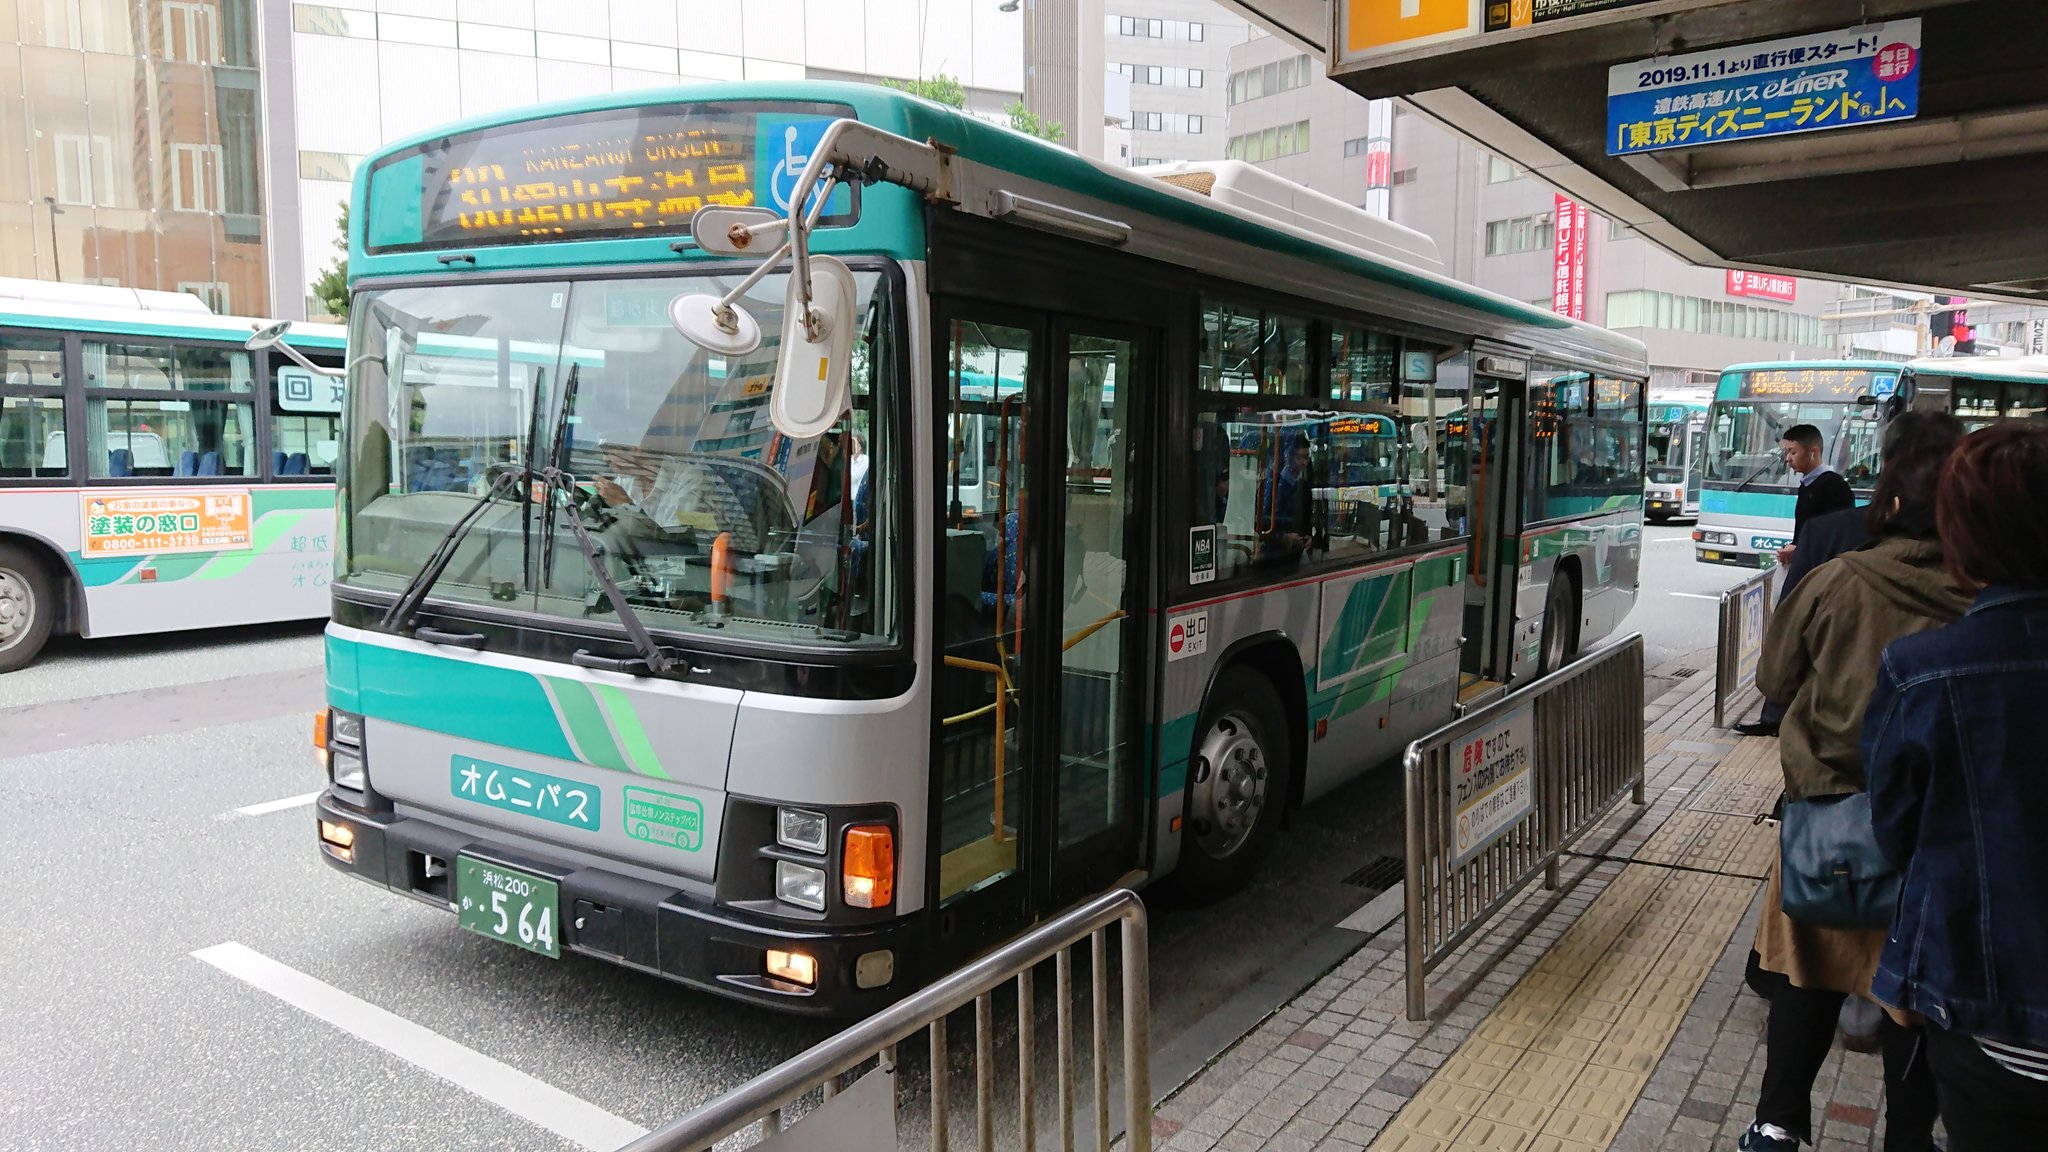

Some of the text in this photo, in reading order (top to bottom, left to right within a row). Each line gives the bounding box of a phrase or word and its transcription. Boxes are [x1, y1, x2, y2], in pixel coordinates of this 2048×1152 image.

[1879, 47, 1910, 63] 毎日
[1879, 62, 1910, 78] 運行
[1653, 85, 1759, 116] 遠鉄高速バス
[90, 513, 198, 536] 塗装の窓口
[103, 535, 199, 550] 0800-111-3739
[1194, 538, 1211, 553] NBA
[1186, 616, 1207, 638] 出口
[1188, 640, 1203, 653] EXIT
[460, 764, 589, 824] オムニバス
